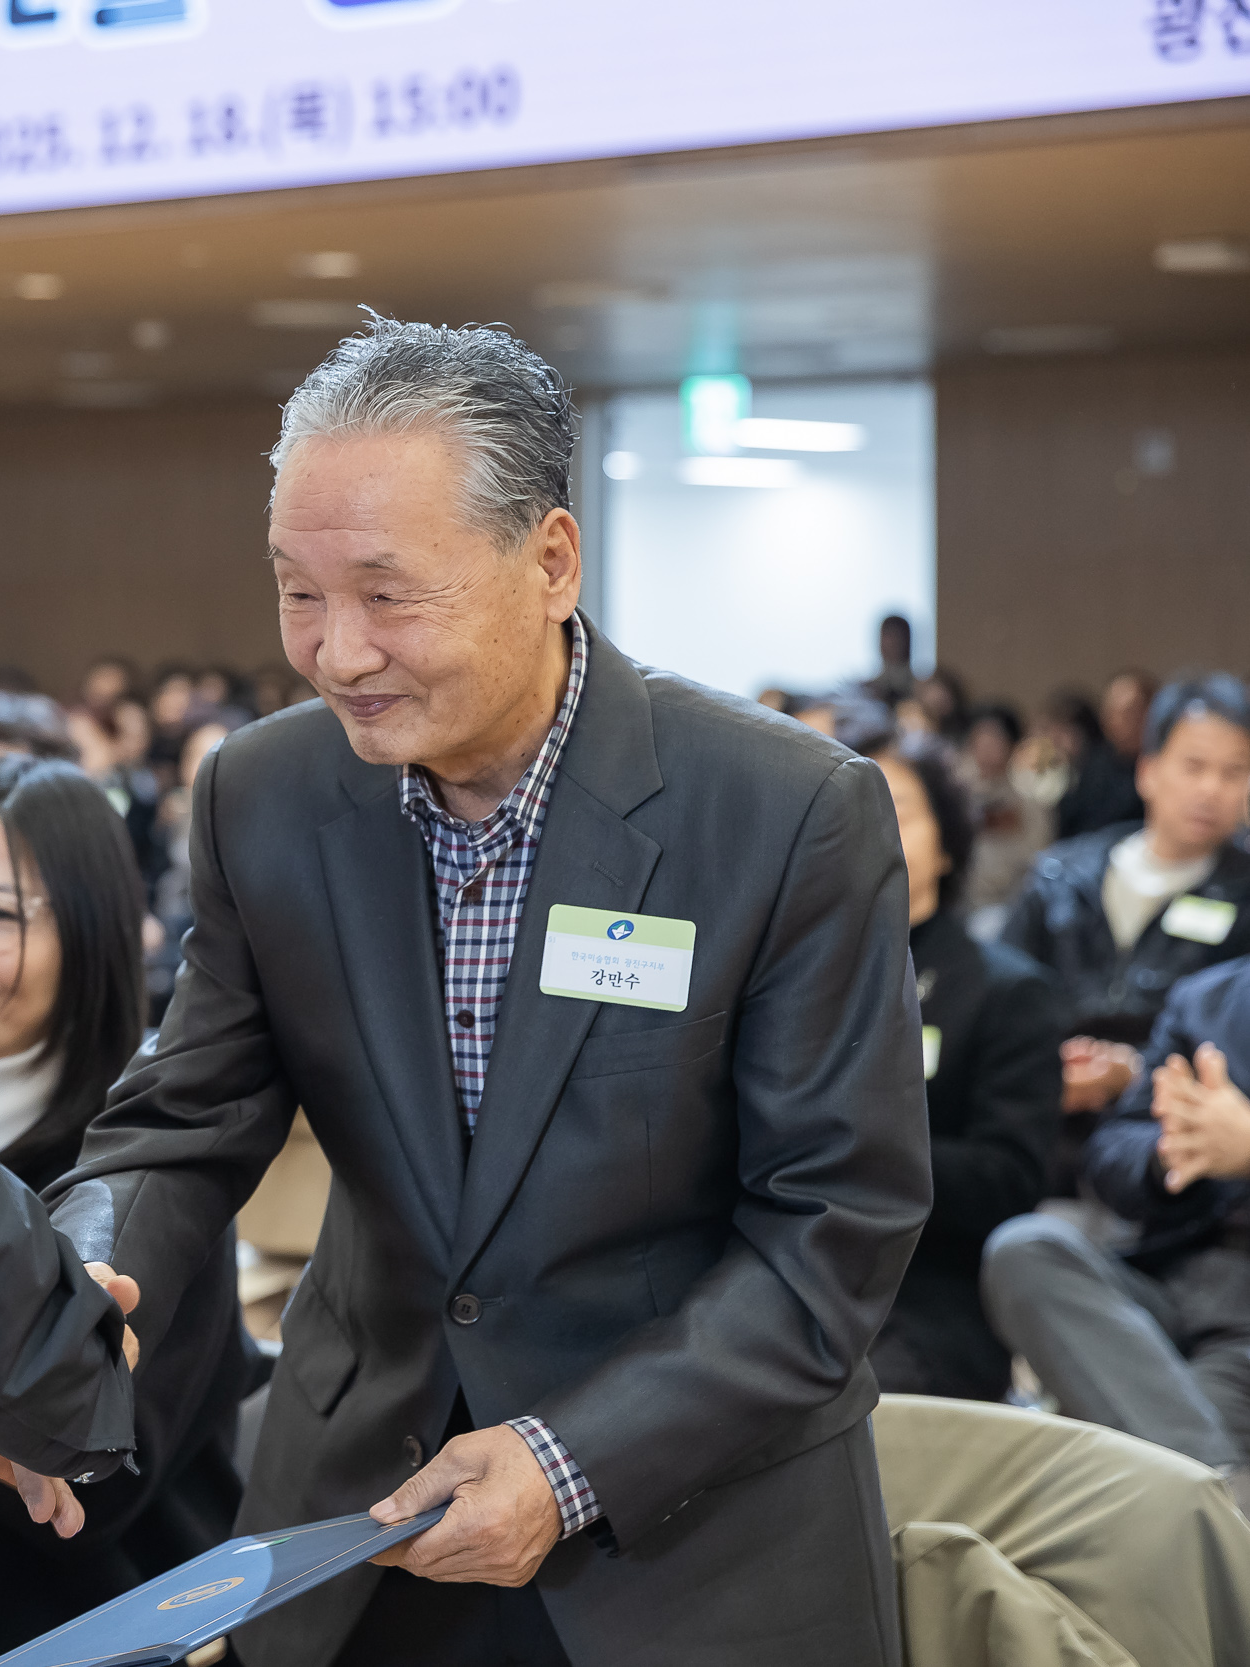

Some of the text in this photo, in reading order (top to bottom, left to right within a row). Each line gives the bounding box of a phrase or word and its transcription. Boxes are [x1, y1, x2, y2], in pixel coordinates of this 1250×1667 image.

[368, 66, 521, 140] 15:00
[571, 951, 665, 971] 한국미술협회 광진구지부
[590, 968, 641, 990] 강만수
